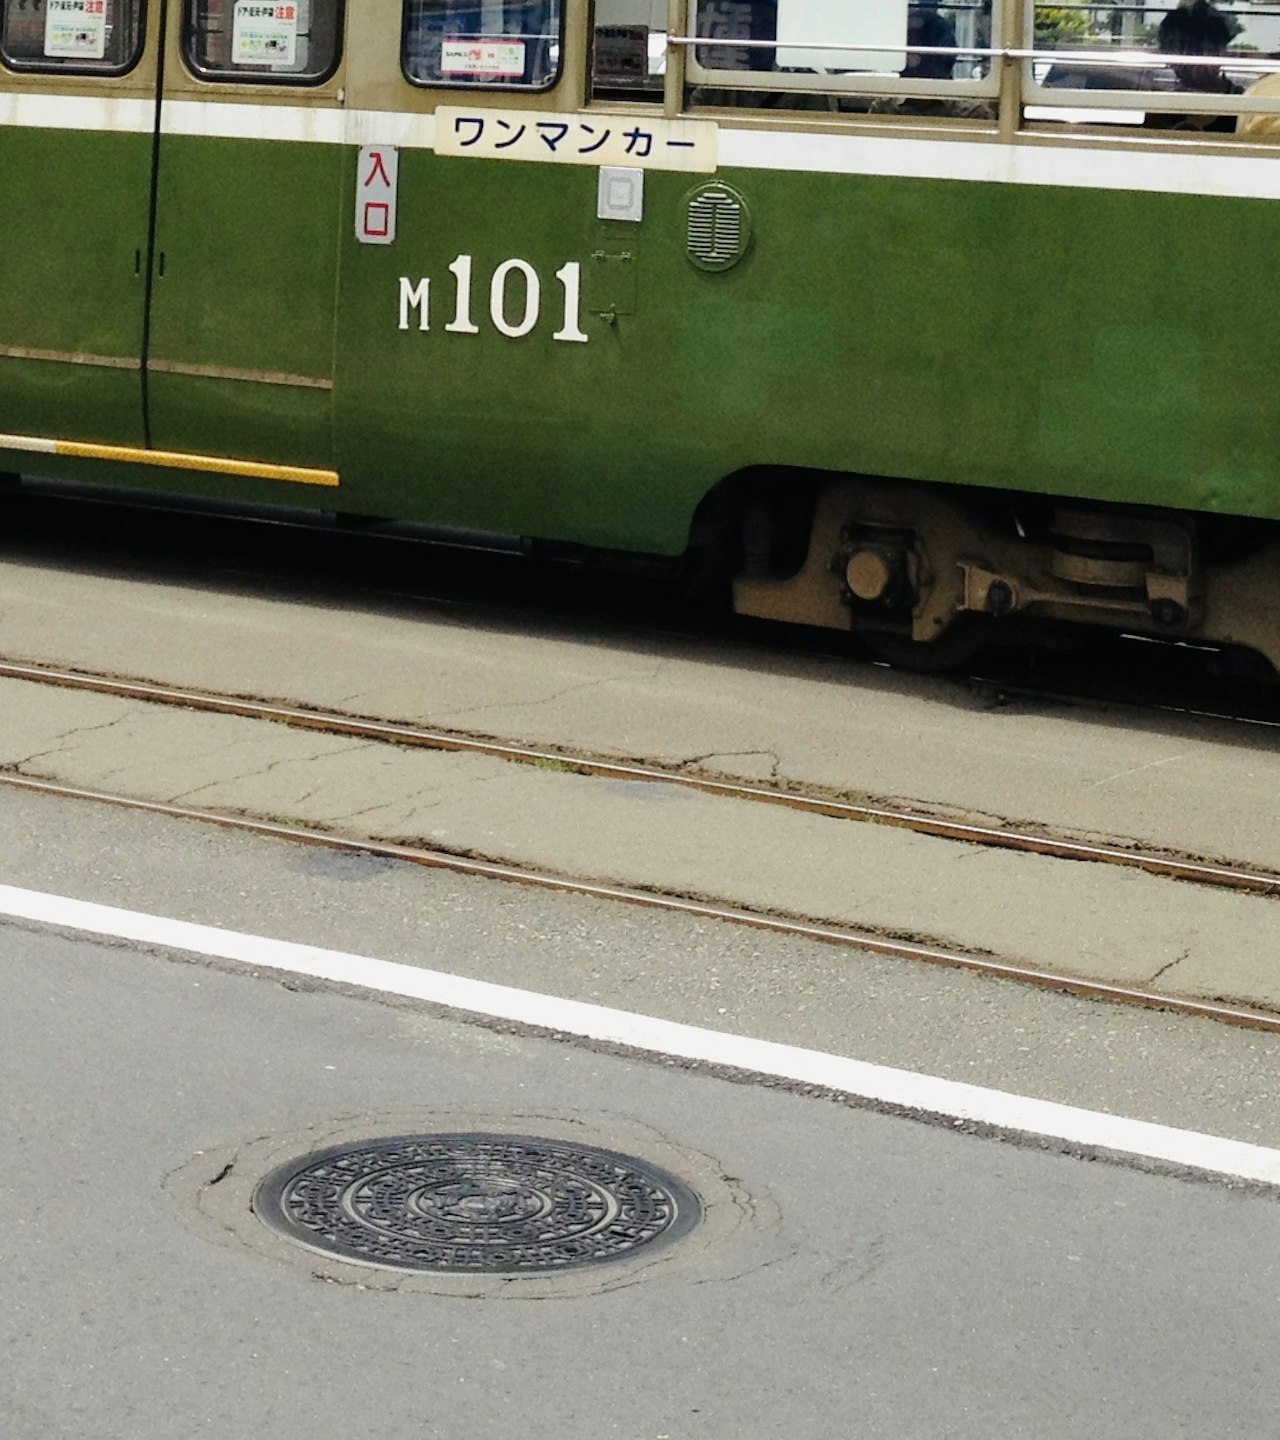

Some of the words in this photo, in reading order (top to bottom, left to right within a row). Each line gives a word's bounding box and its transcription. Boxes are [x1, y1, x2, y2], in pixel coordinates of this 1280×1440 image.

[453, 117, 696, 158] ワンマンカー
[363, 152, 390, 236] 入口
[398, 254, 588, 342] M101
